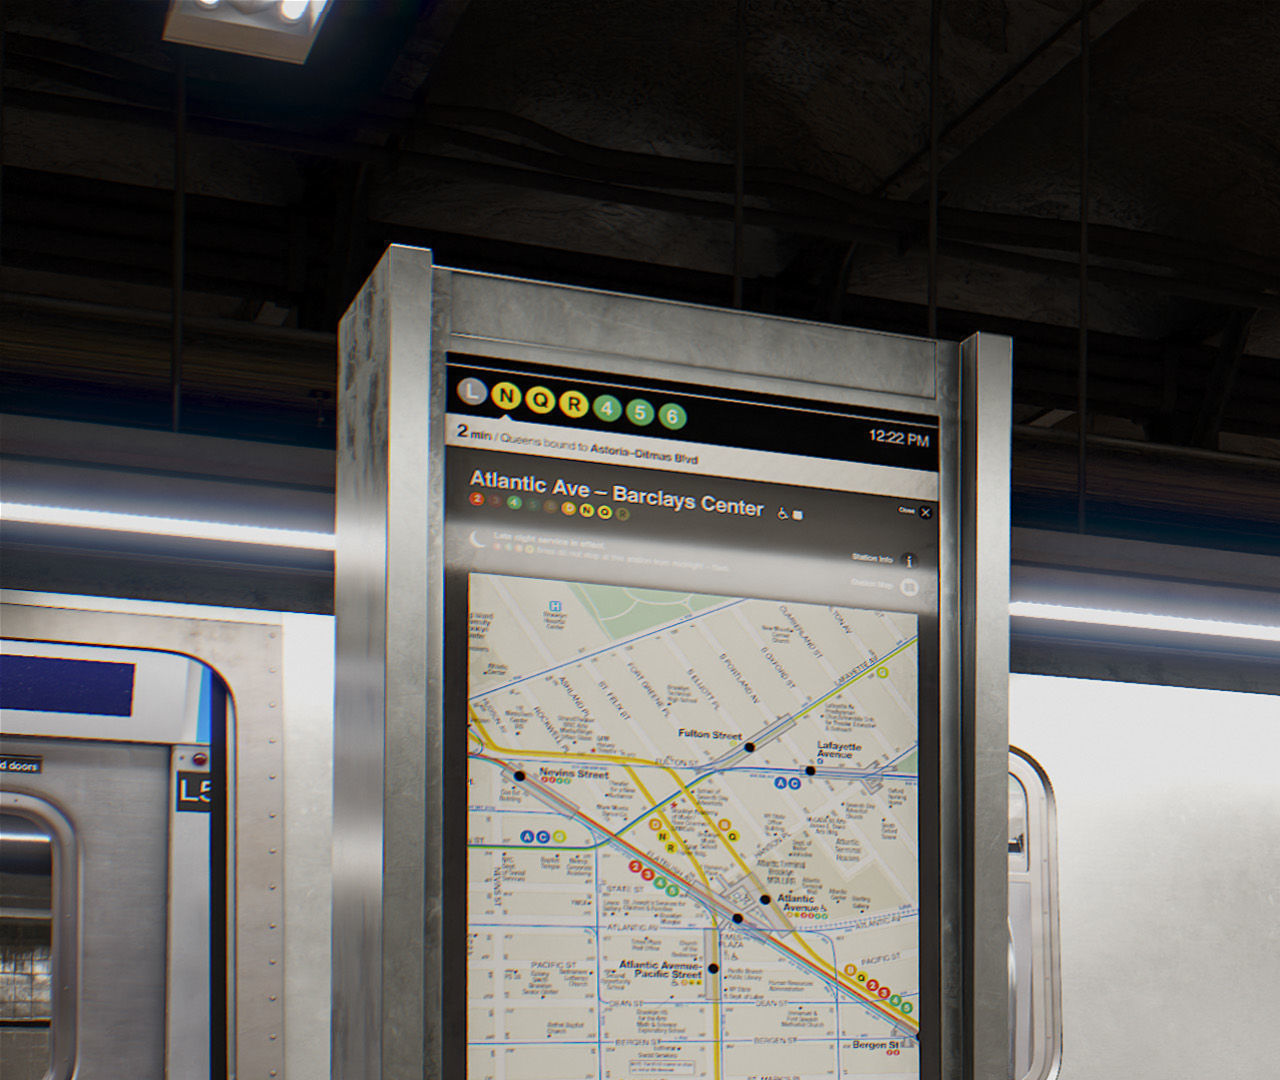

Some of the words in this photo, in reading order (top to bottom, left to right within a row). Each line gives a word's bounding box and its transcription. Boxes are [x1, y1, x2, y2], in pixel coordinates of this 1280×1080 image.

[868, 428, 905, 446] 12:22
[907, 433, 931, 448] PM
[456, 424, 468, 438] 2
[470, 430, 492, 442] min
[578, 442, 590, 452] to
[675, 453, 699, 465] Blvd
[470, 470, 547, 493] Atlantic
[552, 478, 591, 498] Ave
[612, 485, 696, 512] Barclays
[700, 495, 765, 517] Center
[678, 728, 711, 740] Fulton
[712, 730, 743, 741] Street
[817, 740, 863, 754] Lafayette
[817, 750, 854, 760] Avenue
[8, 760, 38, 771] doors
[539, 766, 575, 778] Nevins
[577, 768, 610, 779] Street
[777, 893, 815, 903] Atlantic
[783, 903, 819, 912] Avenue
[619, 959, 659, 969] Atlantic
[634, 969, 670, 978] Pacific
[671, 970, 702, 979] Street
[852, 1040, 887, 1050] Bergen
[888, 1041, 900, 1049] St
